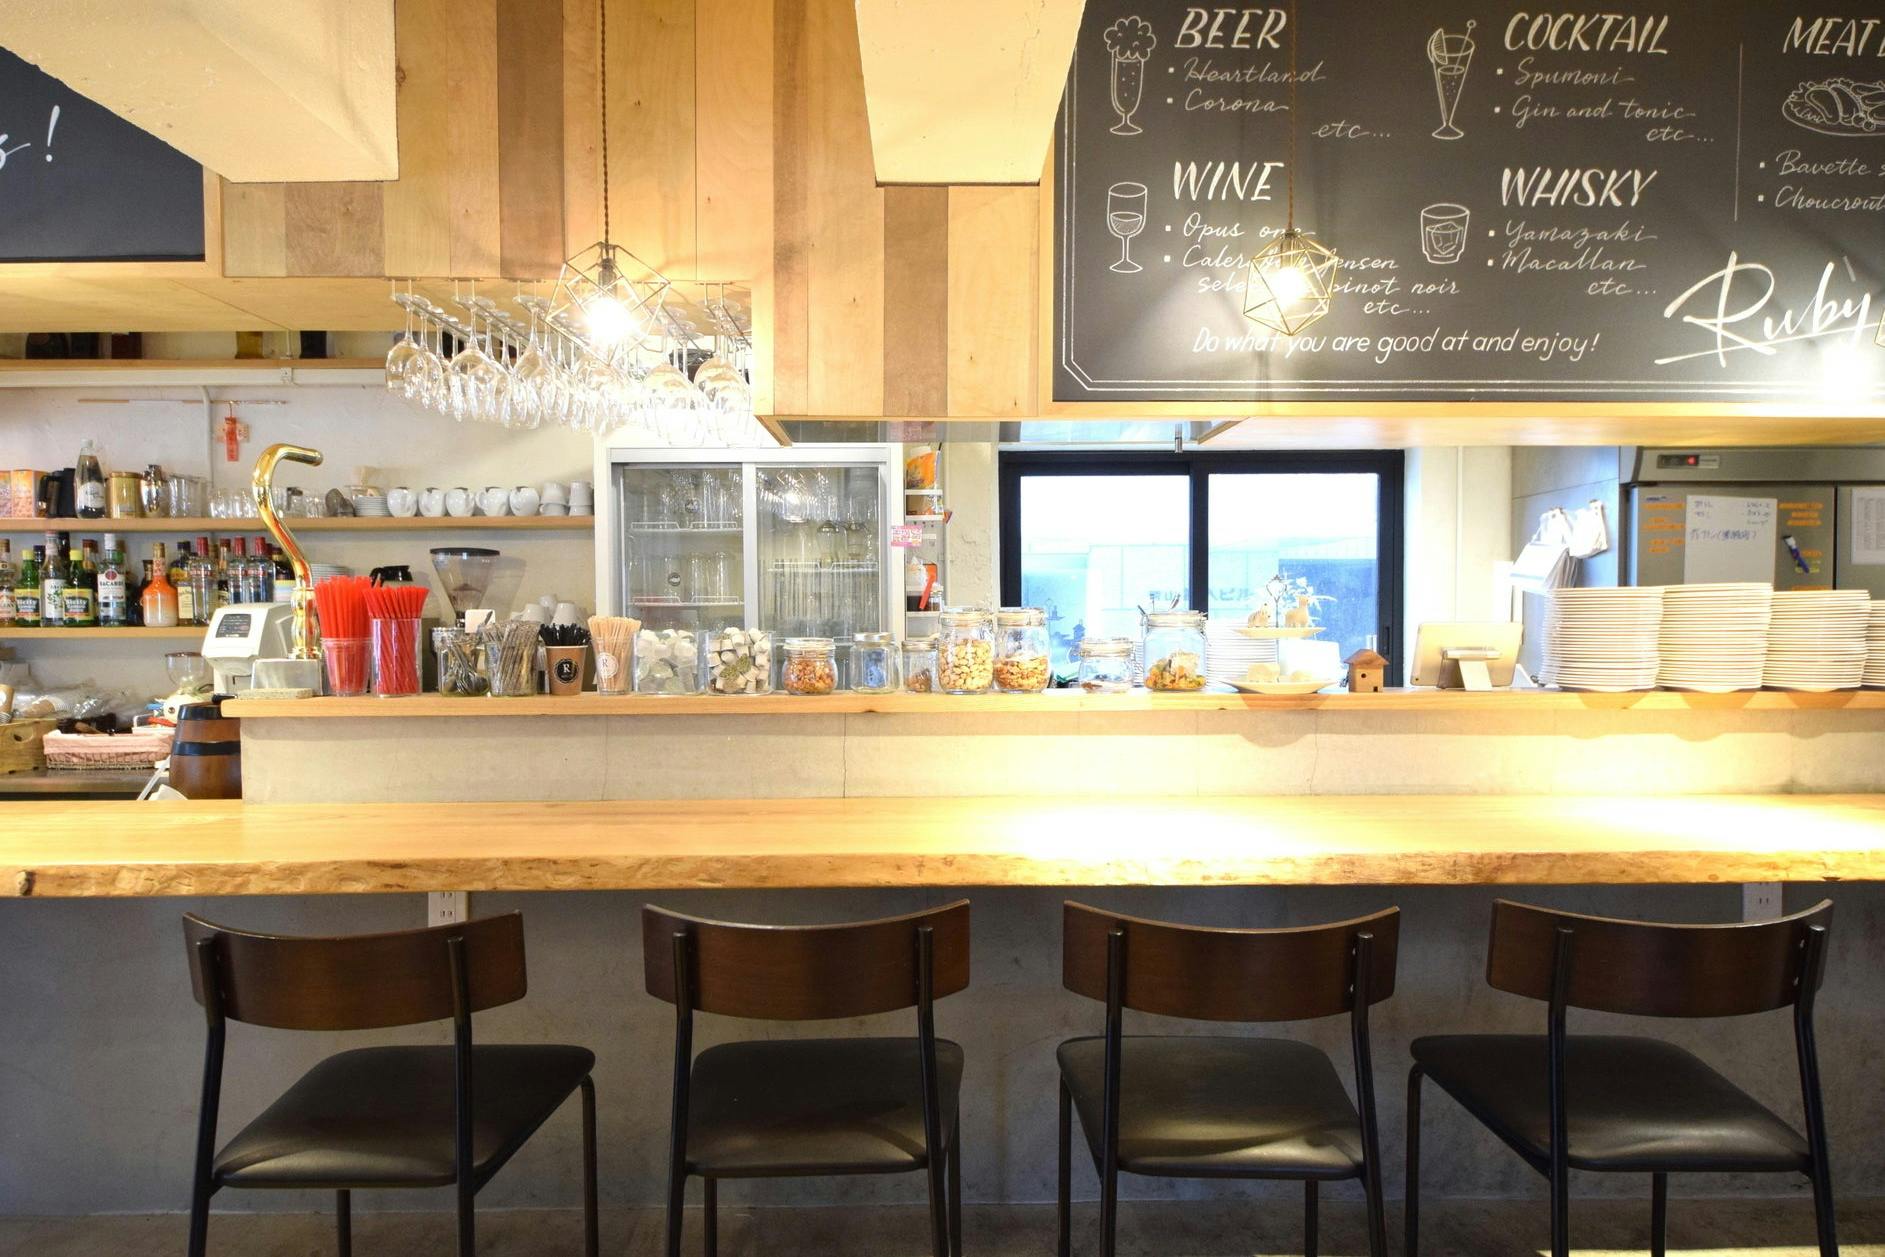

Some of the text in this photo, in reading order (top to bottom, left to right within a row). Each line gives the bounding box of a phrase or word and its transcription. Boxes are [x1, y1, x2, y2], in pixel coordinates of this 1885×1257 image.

[1174, 8, 1288, 50] BEER
[1502, 12, 1670, 54] COCKTAIL
[1782, 16, 1880, 57] MEAT
[1184, 57, 1326, 84] Heartland
[1514, 57, 1636, 89] Spumoni
[1185, 89, 1290, 113] Corona
[1512, 95, 1696, 129] Gin and tonic
[1776, 149, 1871, 176] Bavette
[1173, 161, 1285, 201] WINE
[1500, 166, 1658, 208] WHISKY
[1183, 212, 1245, 242] Opus
[1504, 220, 1658, 247] Yamazaki
[1502, 247, 1647, 272] Macallan
[1411, 279, 1461, 295] noir
[1192, 328, 1600, 364] Do what you are good at and enjoy!
[563, 663, 571, 673] R
